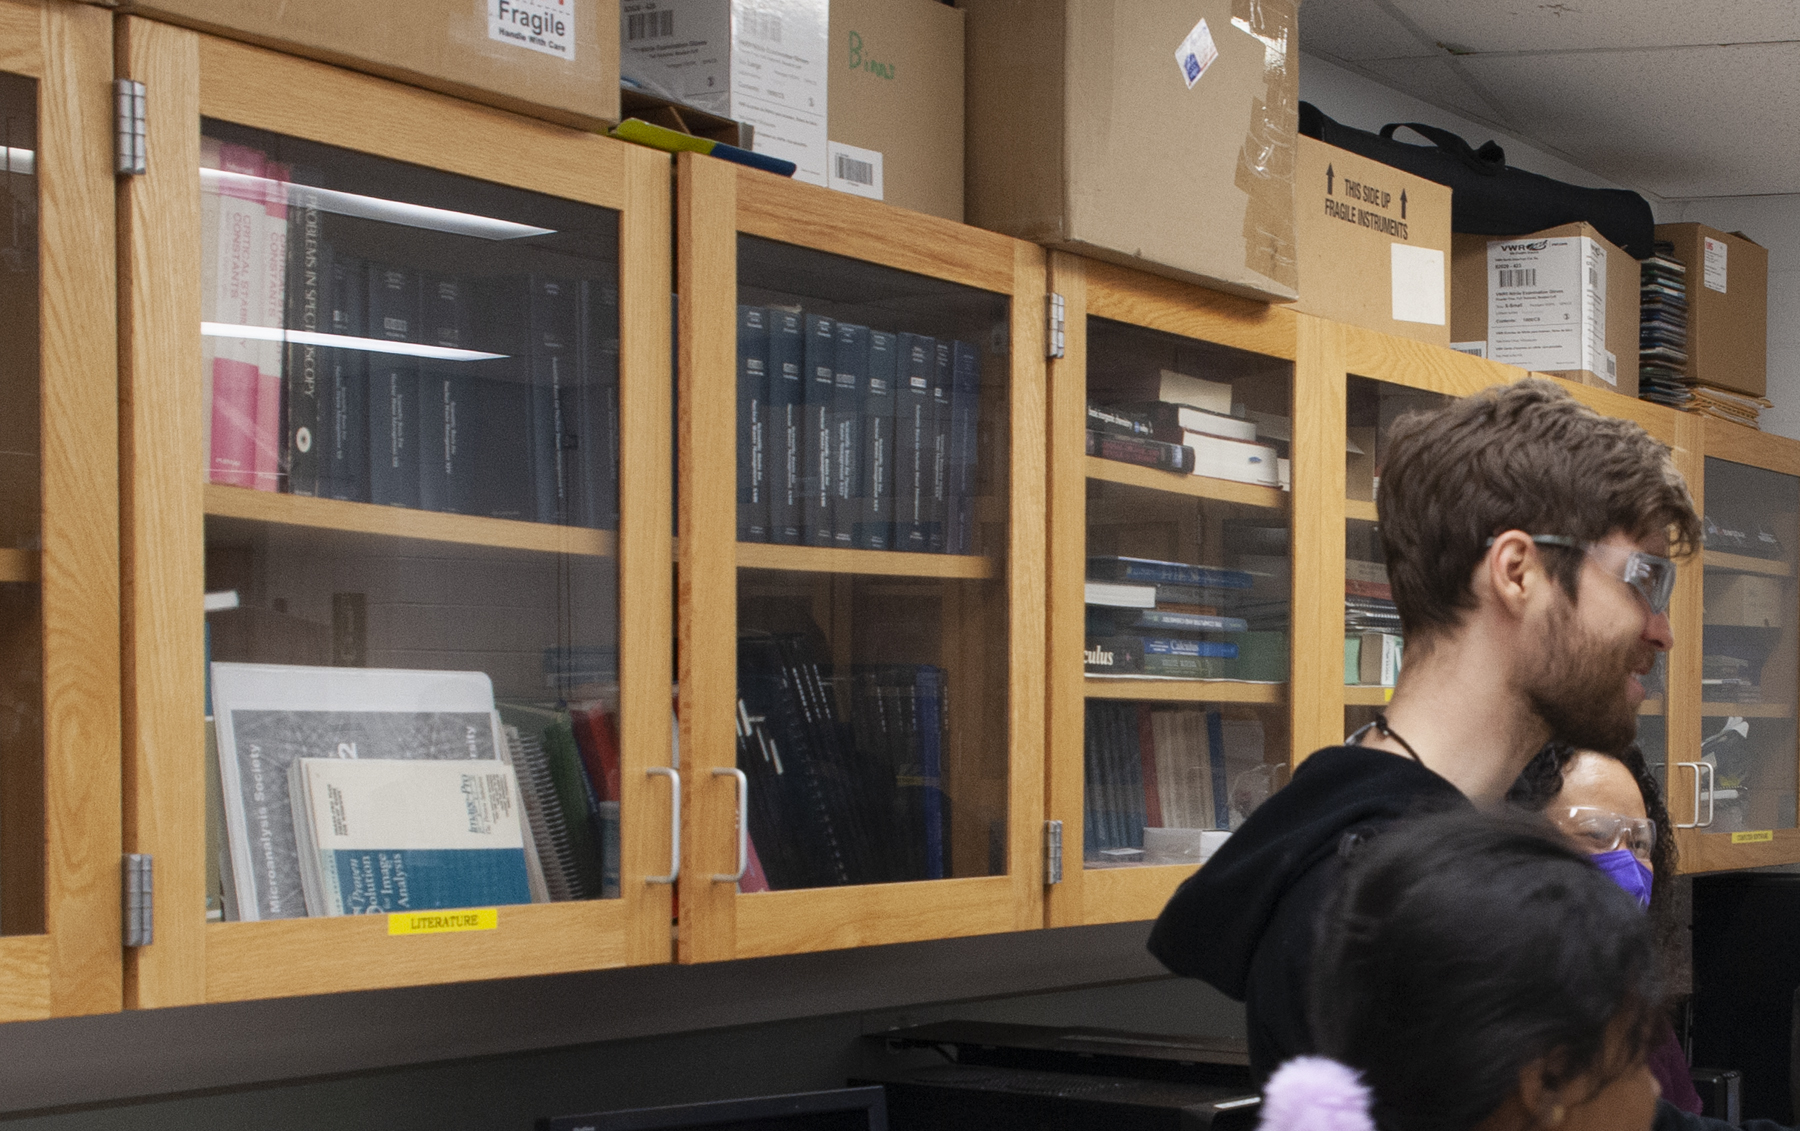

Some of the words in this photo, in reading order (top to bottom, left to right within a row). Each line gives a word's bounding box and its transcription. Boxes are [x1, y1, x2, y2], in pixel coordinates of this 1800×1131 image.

[498, 0, 565, 36] Fragile
[498, 27, 526, 41] Handle
[528, 35, 546, 46] With
[548, 40, 566, 52] Care
[1344, 178, 1361, 200] THIS
[1363, 185, 1380, 207] SIDE
[1381, 191, 1391, 209] UP
[1325, 198, 1356, 223] FRAGILE
[1357, 208, 1409, 241] INSTRUMENTS
[231, 211, 242, 299] CONSTANTS
[241, 214, 250, 275] CRITICAL
[1501, 244, 1526, 252] VWR
[305, 271, 317, 287] IN
[303, 289, 317, 399] SPECTOSCOPY
[1084, 645, 1114, 666] culus
[337, 741, 359, 759] 2
[465, 725, 477, 760] rsity
[249, 743, 265, 802] Society
[258, 805, 282, 914] Microanalysis
[378, 852, 394, 895] Image
[350, 857, 367, 903] Proven
[391, 852, 410, 909] Analysis
[410, 914, 479, 930] LITERATURE
